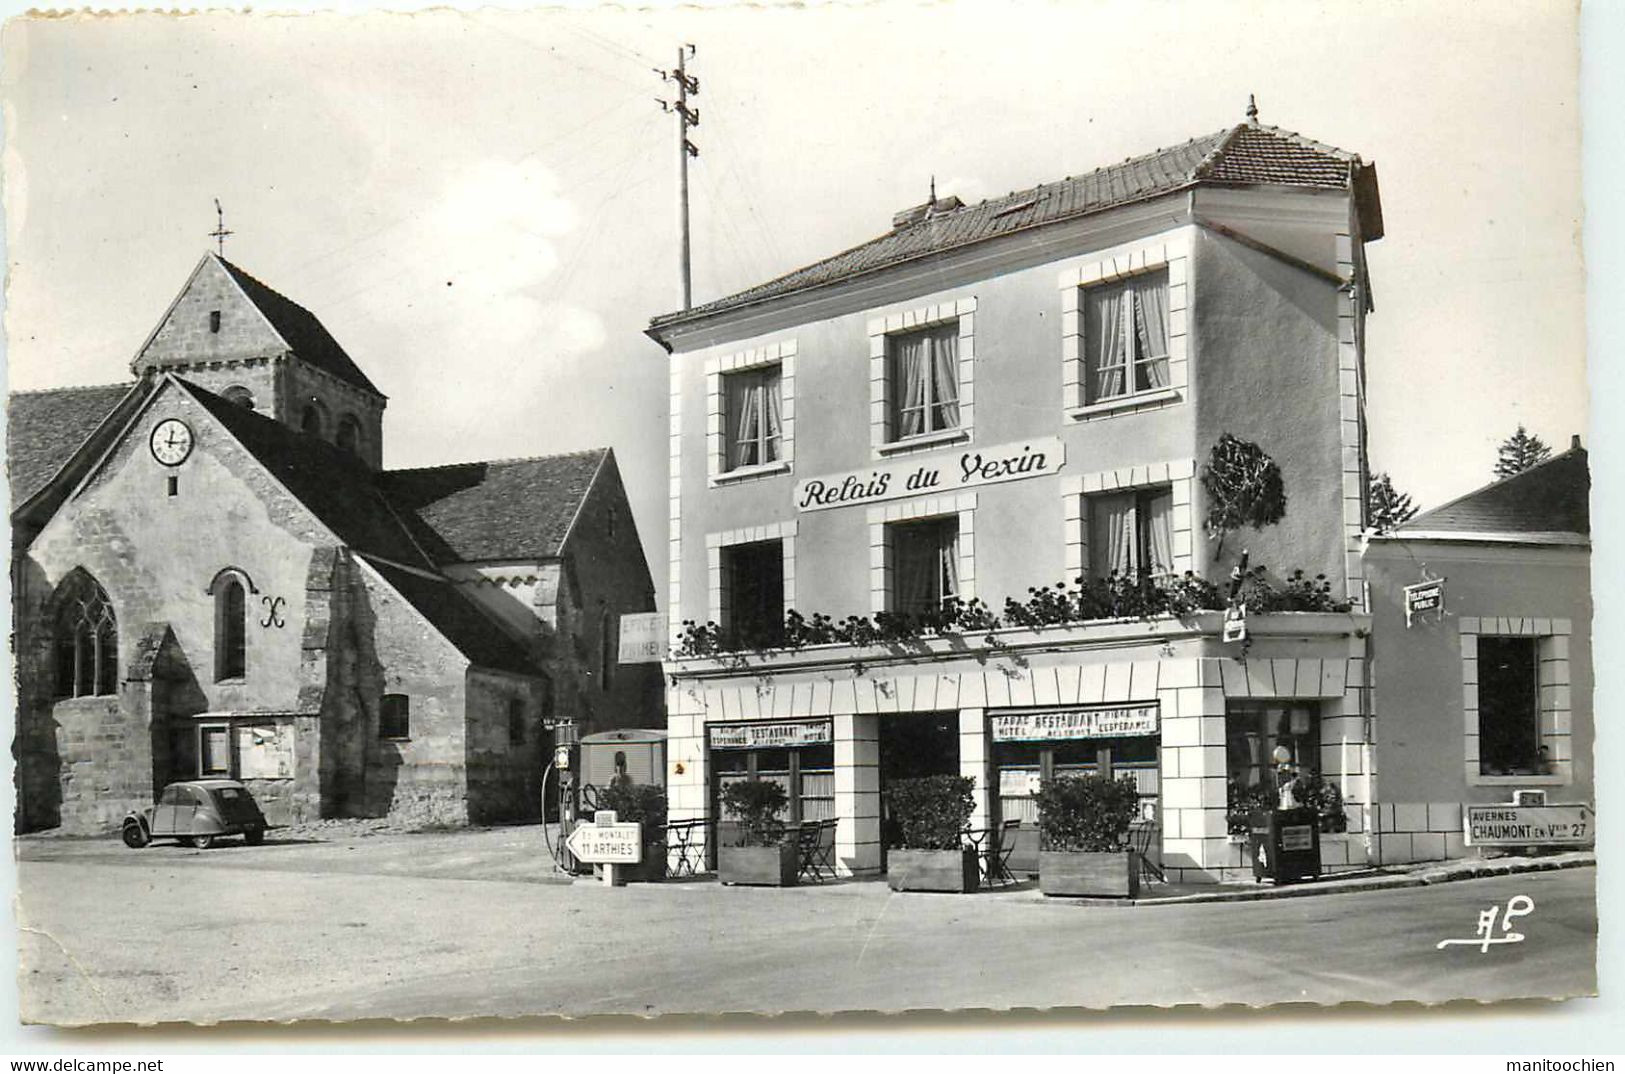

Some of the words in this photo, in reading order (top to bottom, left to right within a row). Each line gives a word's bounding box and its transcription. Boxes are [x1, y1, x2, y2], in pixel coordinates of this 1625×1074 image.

[800, 472, 890, 507] Relais
[906, 467, 941, 491] du
[960, 445, 1048, 484] Vexin
[1035, 713, 1099, 728] RESTAURANT
[1473, 812, 1518, 821] AVERNES
[1473, 824, 1532, 839] CHAUMONT
[1571, 824, 1587, 837] 27
[593, 843, 633, 855] ARTHIES
